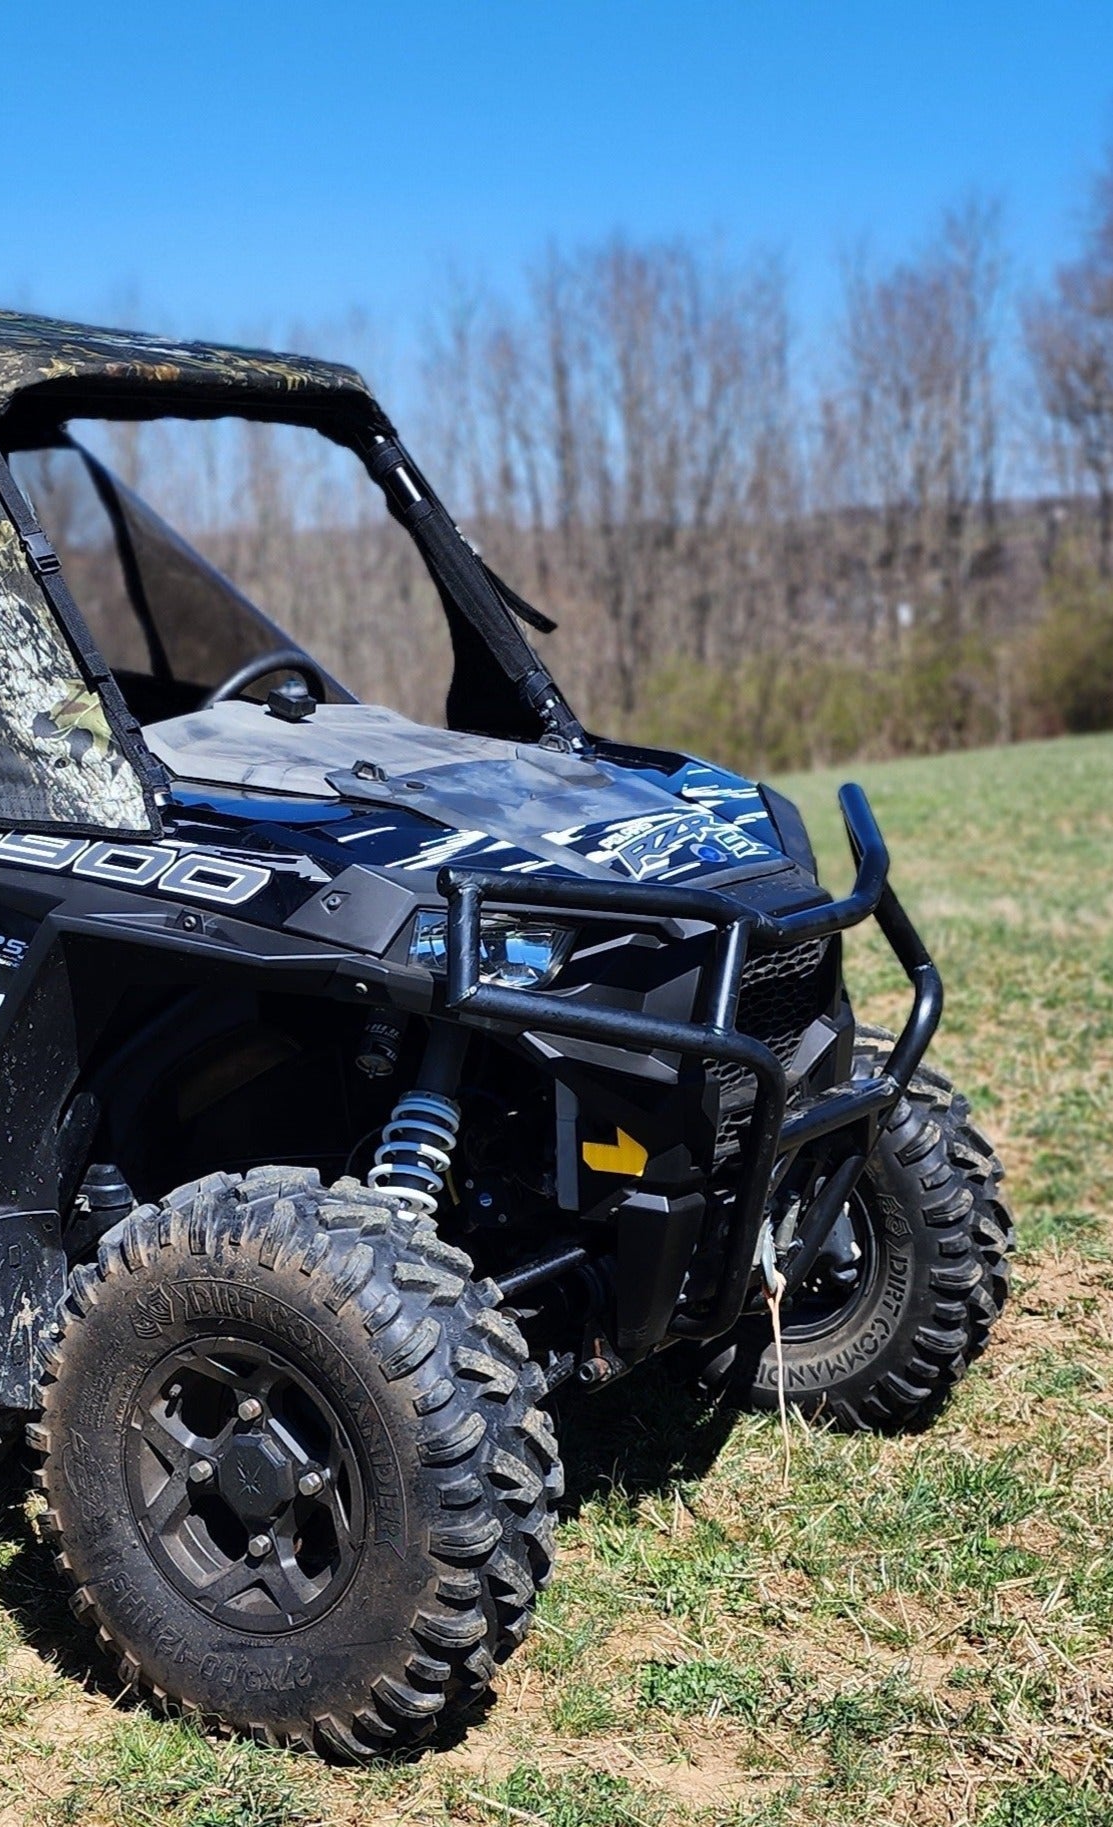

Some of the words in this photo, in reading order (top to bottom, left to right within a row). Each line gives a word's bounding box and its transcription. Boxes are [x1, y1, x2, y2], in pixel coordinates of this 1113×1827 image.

[616, 812, 714, 881] RZR
[188, 1280, 257, 1321] DIRT
[881, 1253, 910, 1318] DIRT
